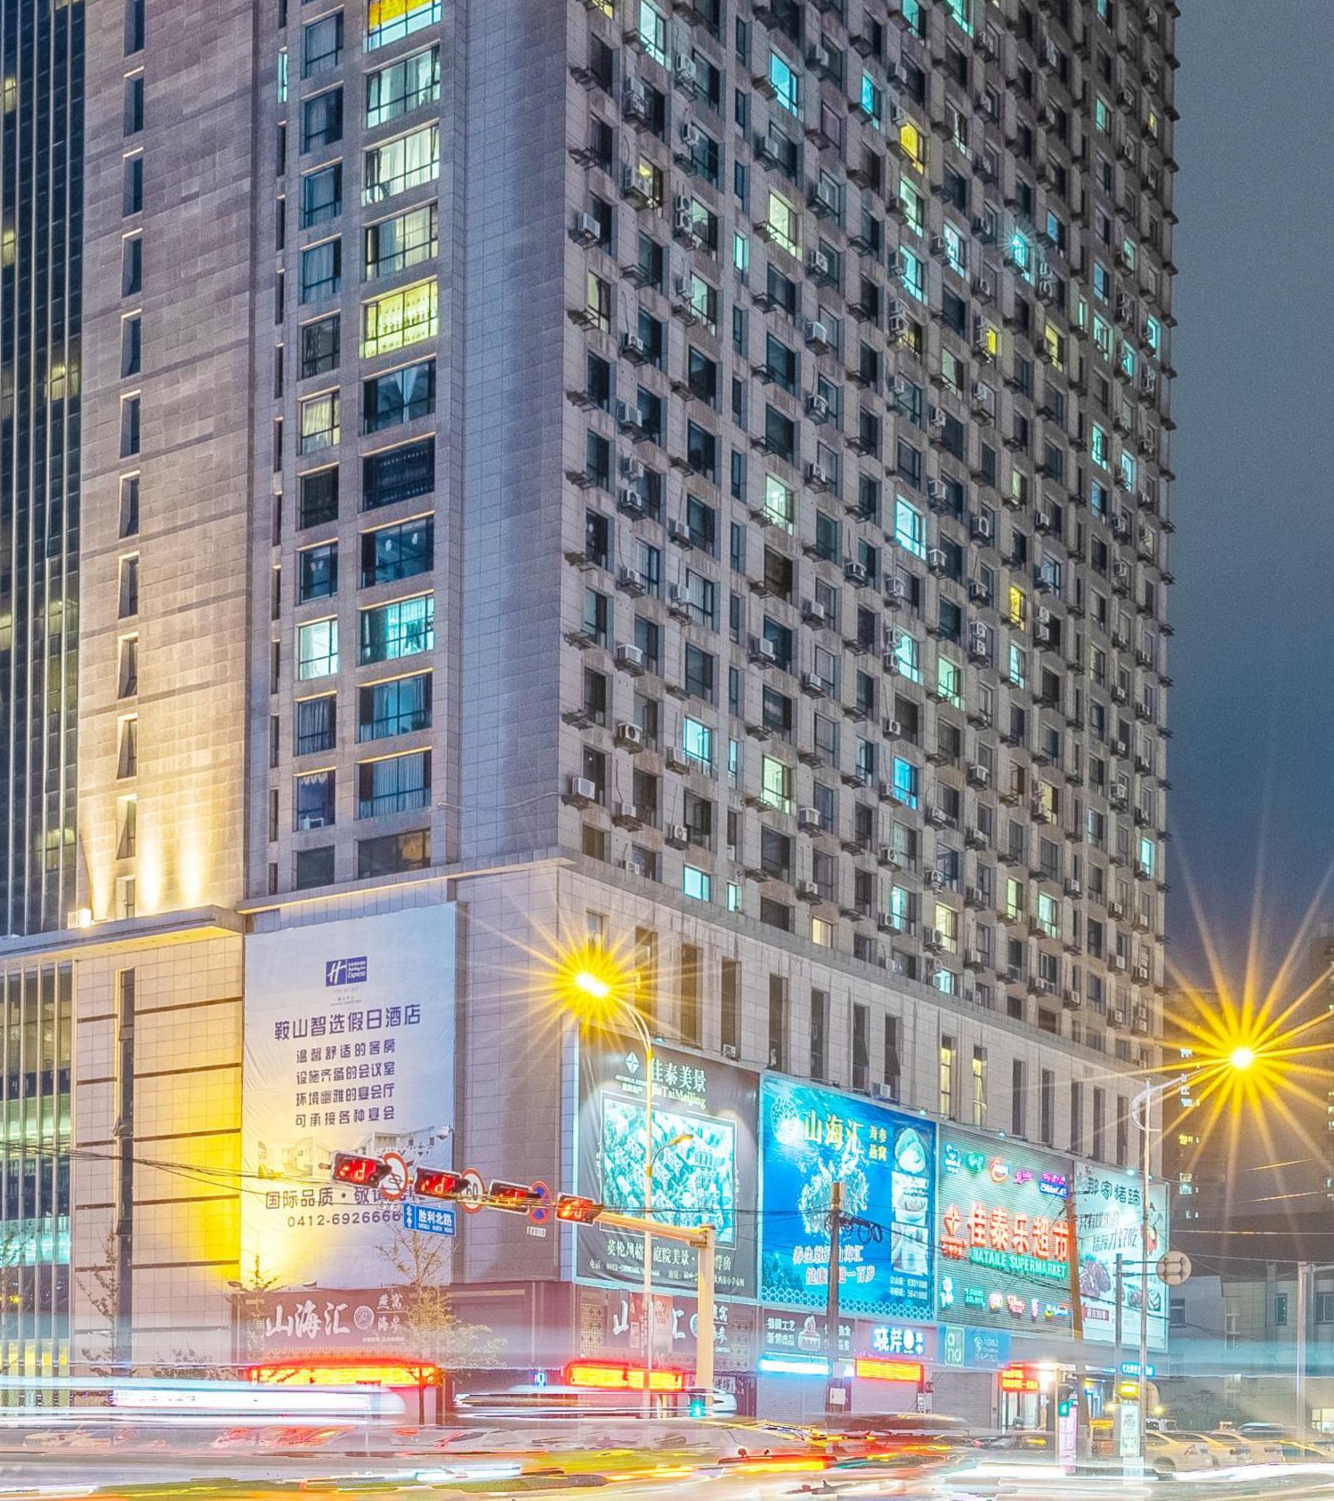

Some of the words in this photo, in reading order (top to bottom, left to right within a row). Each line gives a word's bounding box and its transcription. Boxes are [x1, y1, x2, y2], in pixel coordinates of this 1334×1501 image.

[274, 1004, 421, 1041] 鞍山智选假日酒店
[296, 1038, 396, 1064] 温馨舒适的客房
[296, 1061, 395, 1085] 设施齐备的会议室
[651, 1058, 707, 1093] 佳泰美景
[295, 1082, 395, 1107] 环境幽雅的宴会厅
[295, 1105, 395, 1128] 可承接各种宴会
[804, 1107, 865, 1155] 山海汇
[287, 1210, 402, 1228] 0412-6926666
[967, 1202, 1069, 1262] 佳泰乐超市
[265, 1299, 351, 1340] 山海汇
